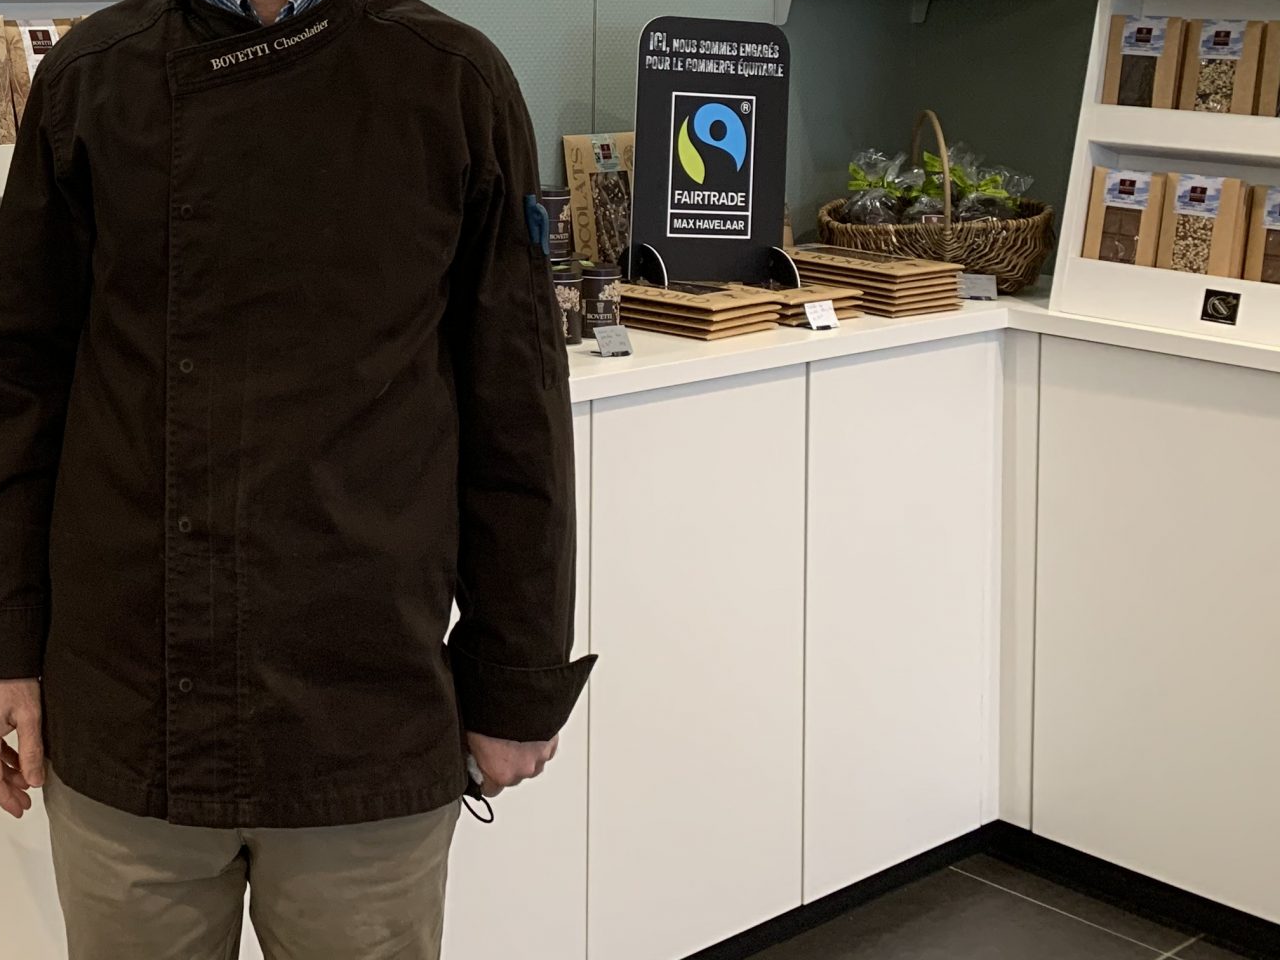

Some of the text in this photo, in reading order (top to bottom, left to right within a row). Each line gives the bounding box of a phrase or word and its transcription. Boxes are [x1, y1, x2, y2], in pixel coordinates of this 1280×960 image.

[210, 18, 329, 71] BOVETTI Chocolatier
[649, 31, 780, 59] ICI, NOUS SOMMES ENGAGÉS
[645, 55, 784, 78] POUR LE COMMERCE ÉQUITABLE
[674, 190, 746, 206] FAIRTRADE
[673, 218, 745, 231] MAX HAVELAAR
[586, 312, 613, 321] BOVETTI
